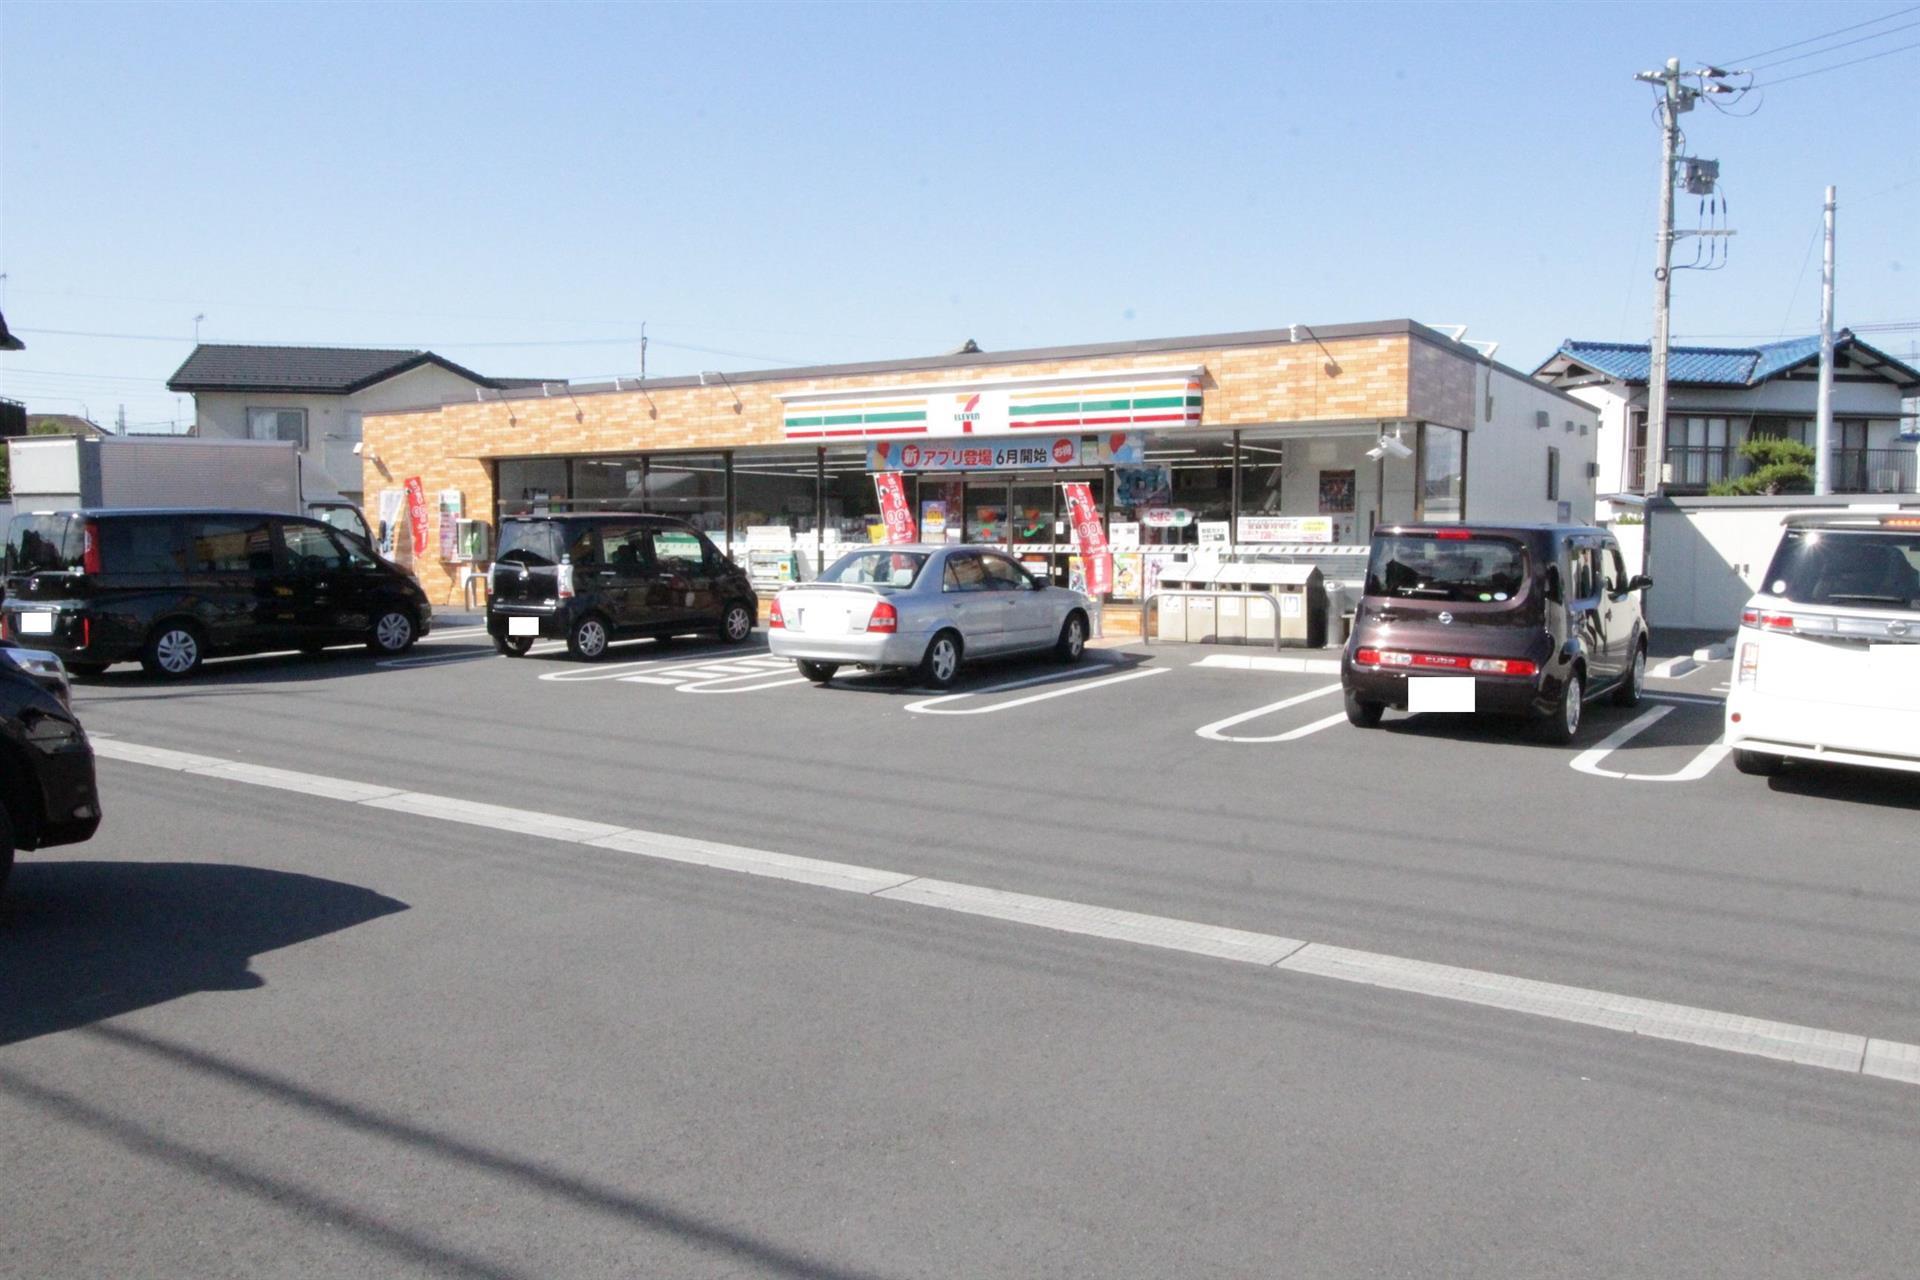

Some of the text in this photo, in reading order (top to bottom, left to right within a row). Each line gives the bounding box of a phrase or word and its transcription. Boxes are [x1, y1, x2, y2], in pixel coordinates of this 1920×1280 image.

[904, 447, 918, 466] 新
[923, 448, 992, 466] アプリ登場
[996, 447, 1047, 465] 6月開始
[1149, 511, 1171, 522] たばこ
